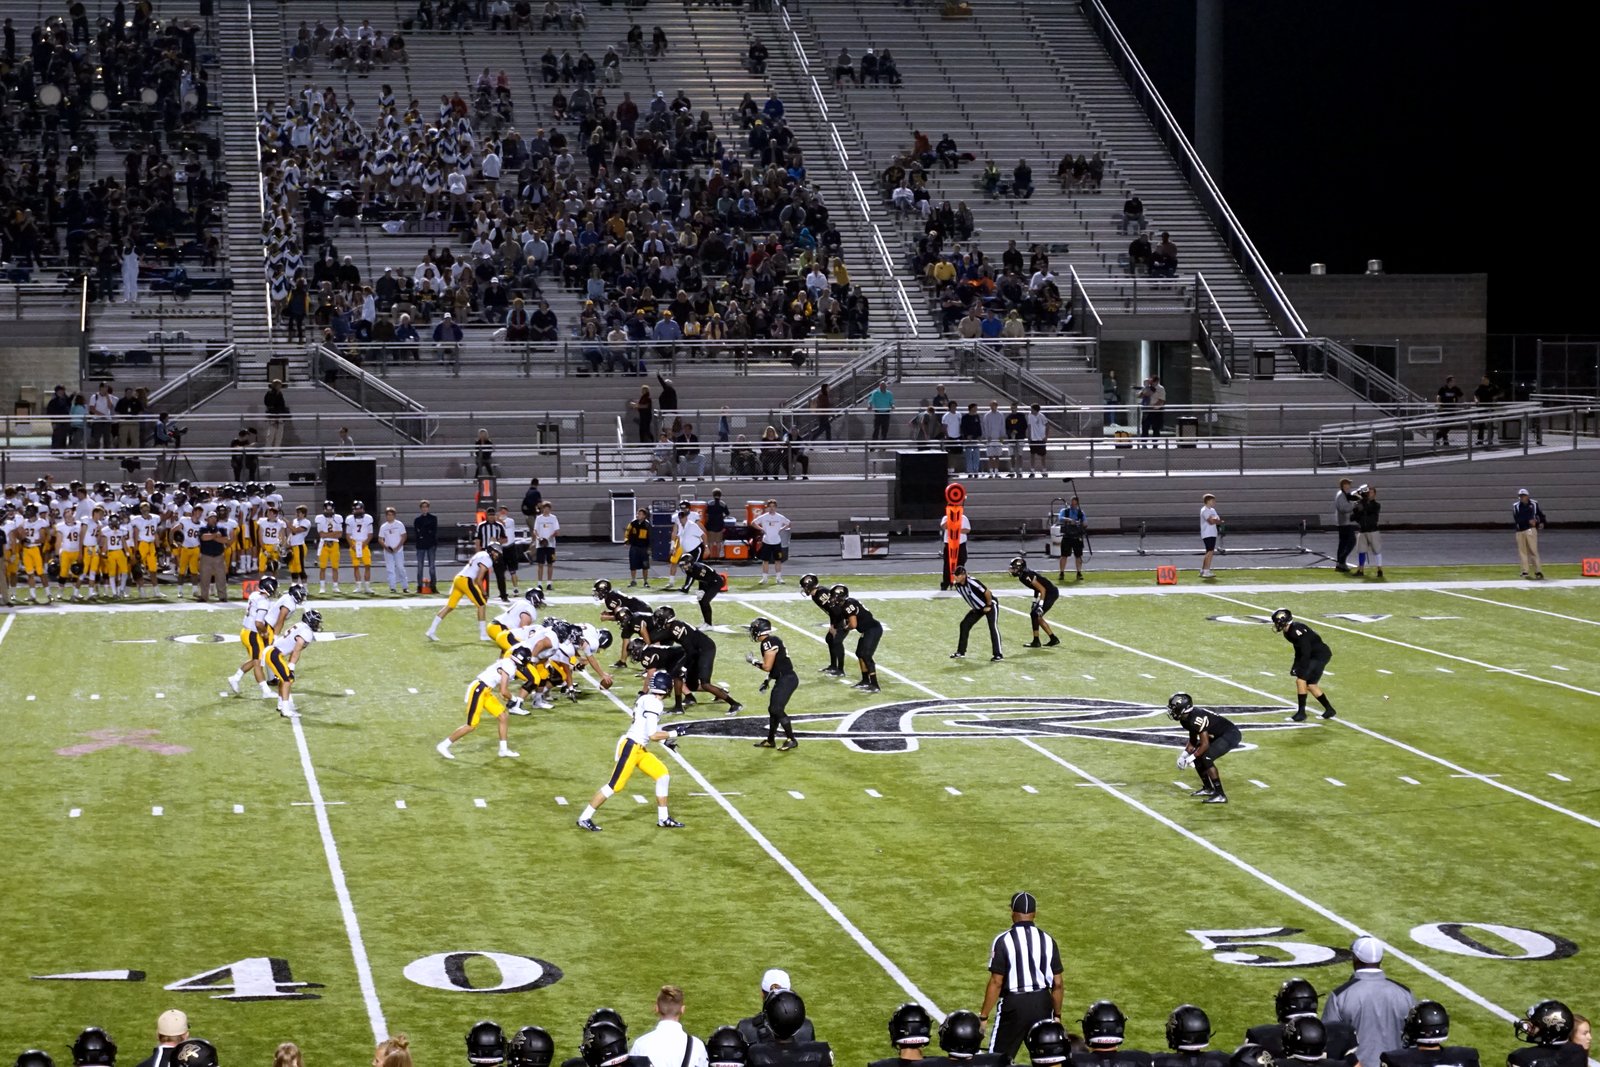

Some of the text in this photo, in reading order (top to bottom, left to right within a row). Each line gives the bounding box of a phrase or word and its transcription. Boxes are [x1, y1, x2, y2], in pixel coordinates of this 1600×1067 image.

[265, 527, 277, 538] 62
[356, 524, 363, 533] 7
[67, 531, 79, 541] 49
[110, 535, 122, 546] 87
[732, 546, 741, 556] G
[1585, 560, 1600, 574] 30
[1161, 568, 1174, 580] 40
[672, 625, 683, 636] 42
[762, 642, 773, 651] 21
[1193, 716, 1205, 727] 10
